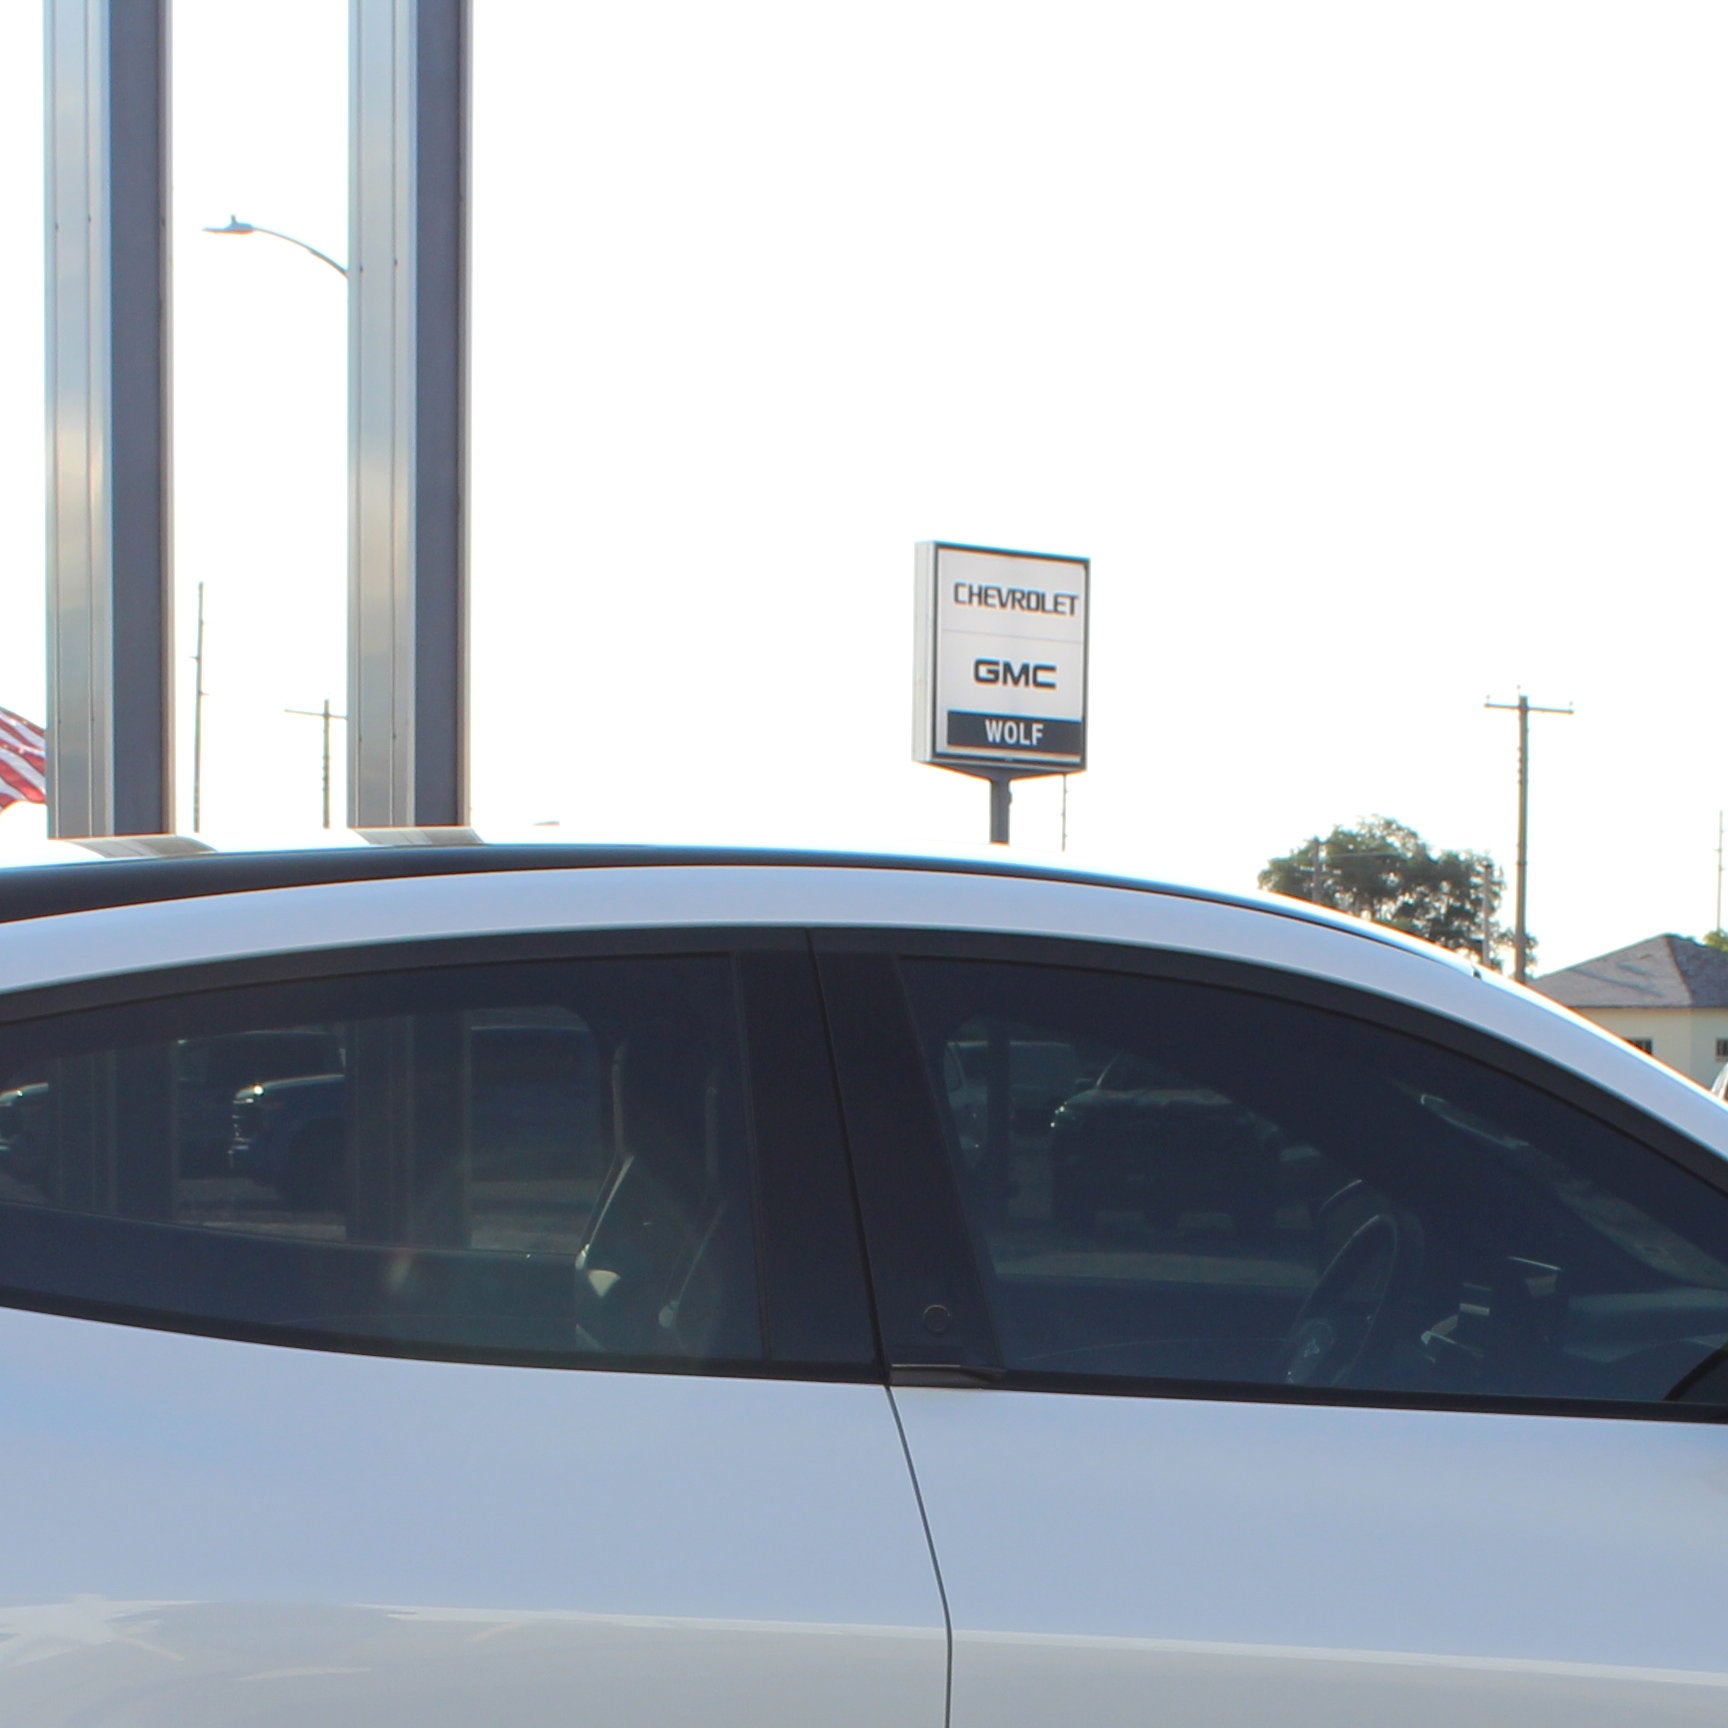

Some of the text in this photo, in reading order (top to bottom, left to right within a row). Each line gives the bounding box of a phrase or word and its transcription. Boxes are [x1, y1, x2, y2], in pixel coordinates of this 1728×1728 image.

[953, 582, 1080, 616] CHEVROLET
[974, 658, 1057, 689] GMC
[985, 719, 1044, 746] WOLF
